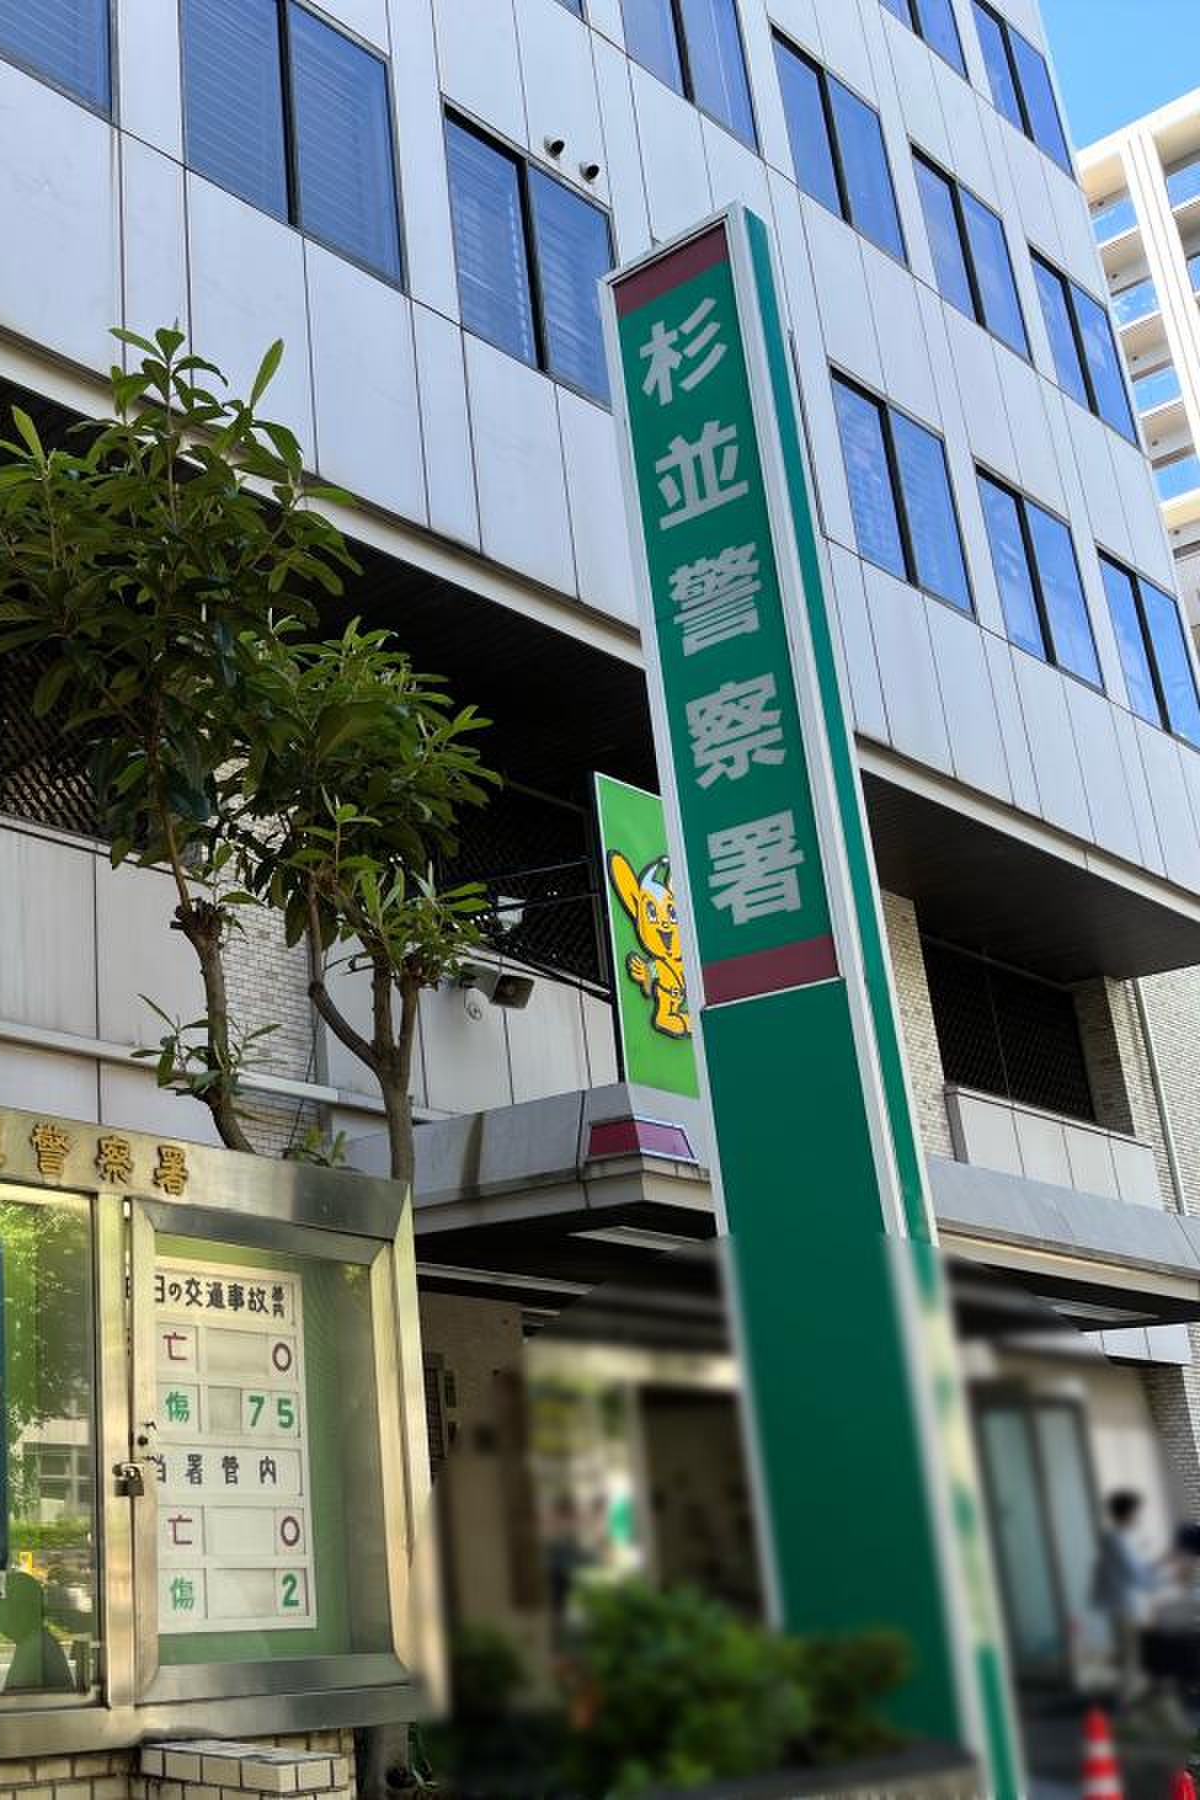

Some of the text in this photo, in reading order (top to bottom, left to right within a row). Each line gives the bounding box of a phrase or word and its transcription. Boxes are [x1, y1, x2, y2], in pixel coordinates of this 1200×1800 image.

[639, 297, 805, 926] 杉並警察署
[271, 1341, 293, 1372] 0
[247, 1394, 295, 1430] 75
[279, 1515, 301, 1547] 0
[281, 1573, 300, 1608] 2
